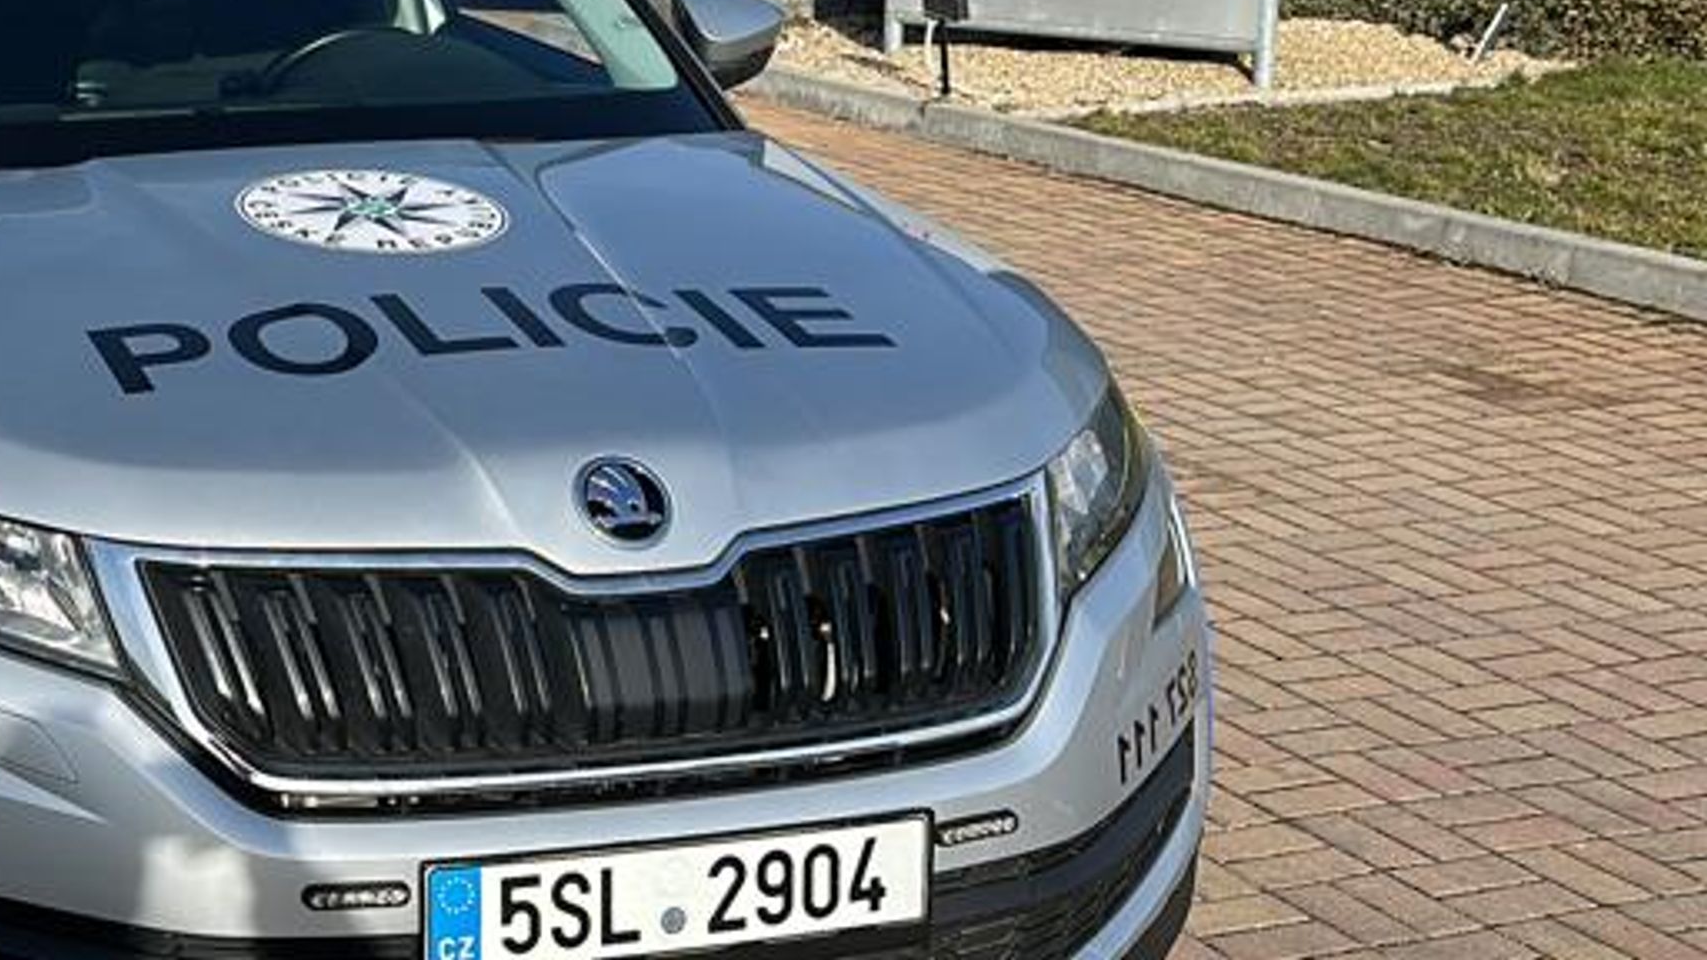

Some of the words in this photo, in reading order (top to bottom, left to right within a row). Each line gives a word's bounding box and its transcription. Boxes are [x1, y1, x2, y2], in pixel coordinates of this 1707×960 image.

[86, 282, 899, 394] POLICIE
[438, 936, 475, 960] CZ
[499, 867, 641, 954] 5SL
[707, 838, 886, 934] 2904
